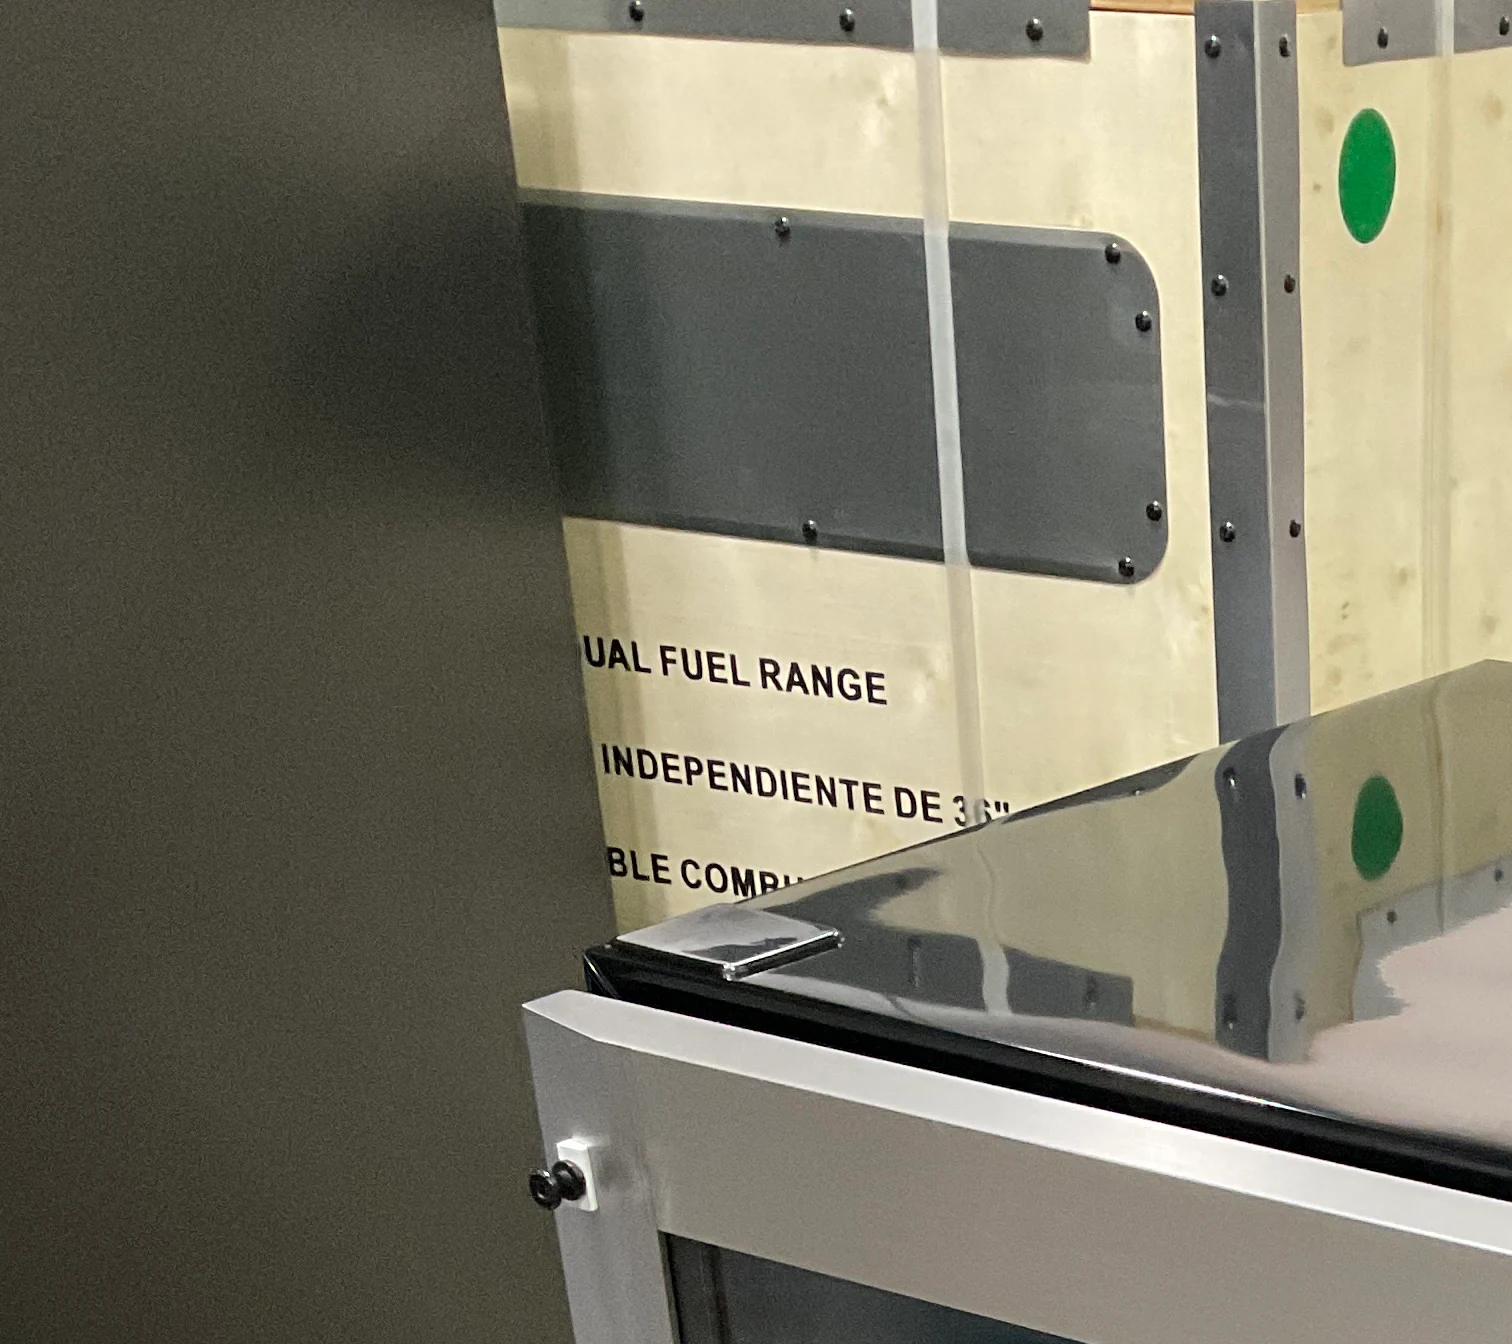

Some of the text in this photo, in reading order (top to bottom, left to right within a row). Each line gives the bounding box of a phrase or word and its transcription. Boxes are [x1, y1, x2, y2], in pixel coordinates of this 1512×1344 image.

[579, 634, 888, 705] UAL FUEL RANGE
[602, 743, 883, 815] INDEPENDIENTE
[894, 786, 943, 823] DE
